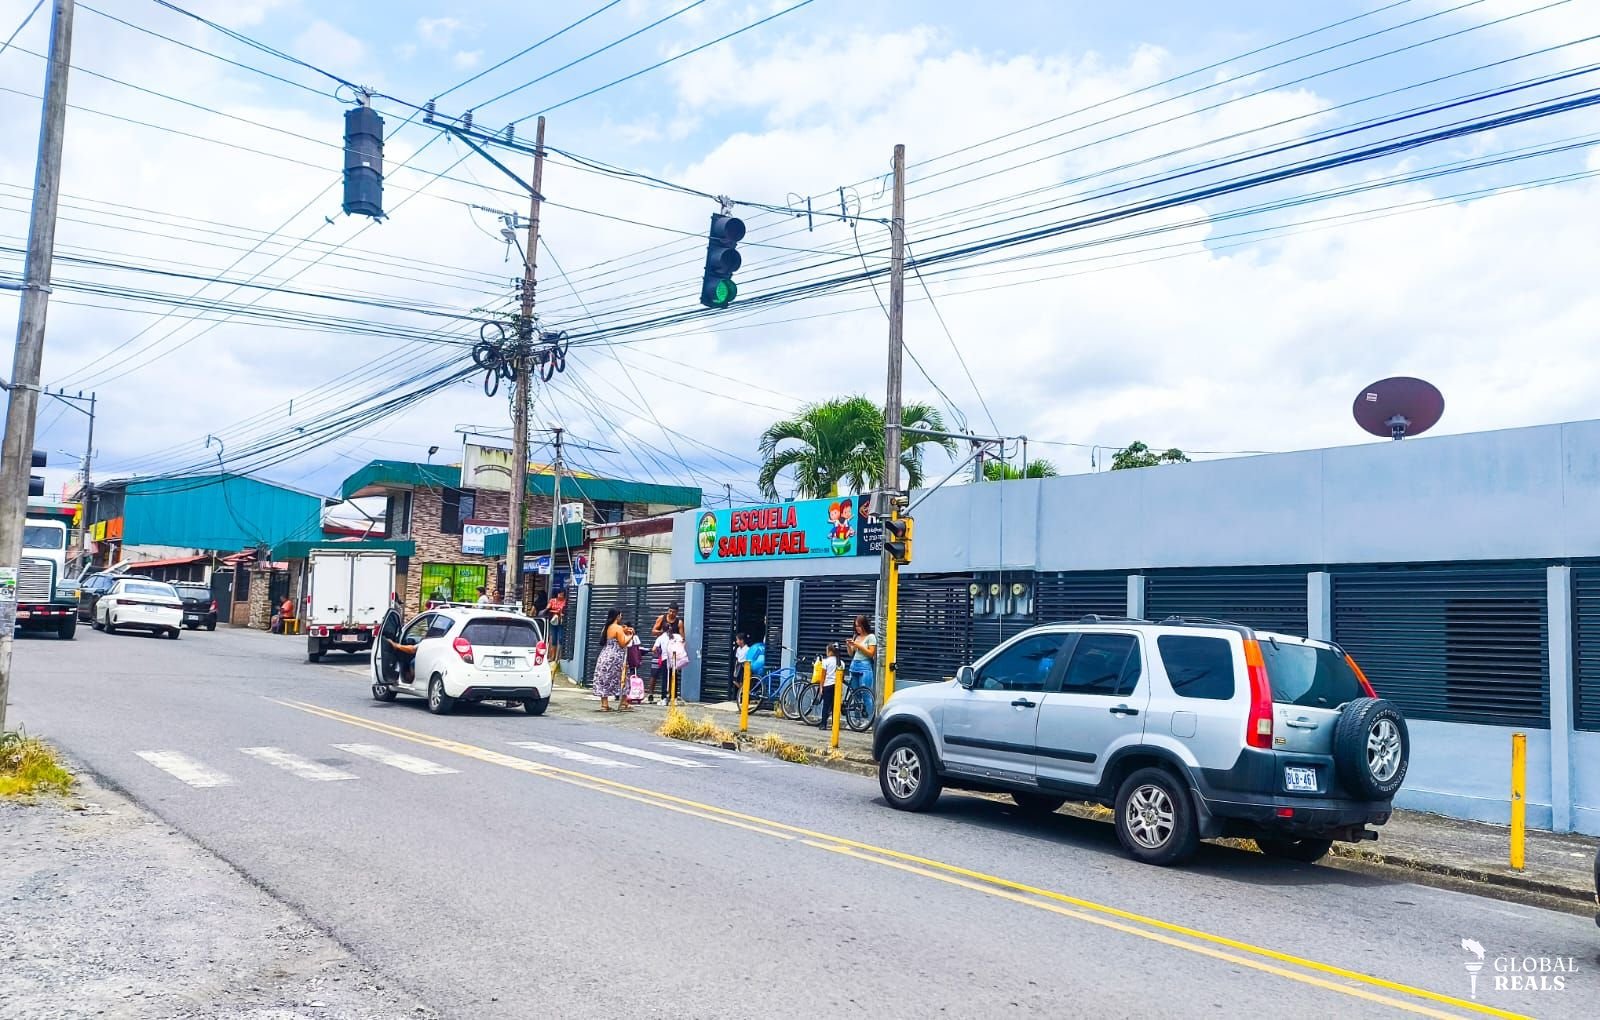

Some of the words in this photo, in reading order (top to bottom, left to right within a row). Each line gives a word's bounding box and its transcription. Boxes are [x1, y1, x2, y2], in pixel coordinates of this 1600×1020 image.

[731, 506, 797, 533] ESCUELA
[718, 535, 748, 557] SAN
[750, 531, 809, 555] RAFAEL
